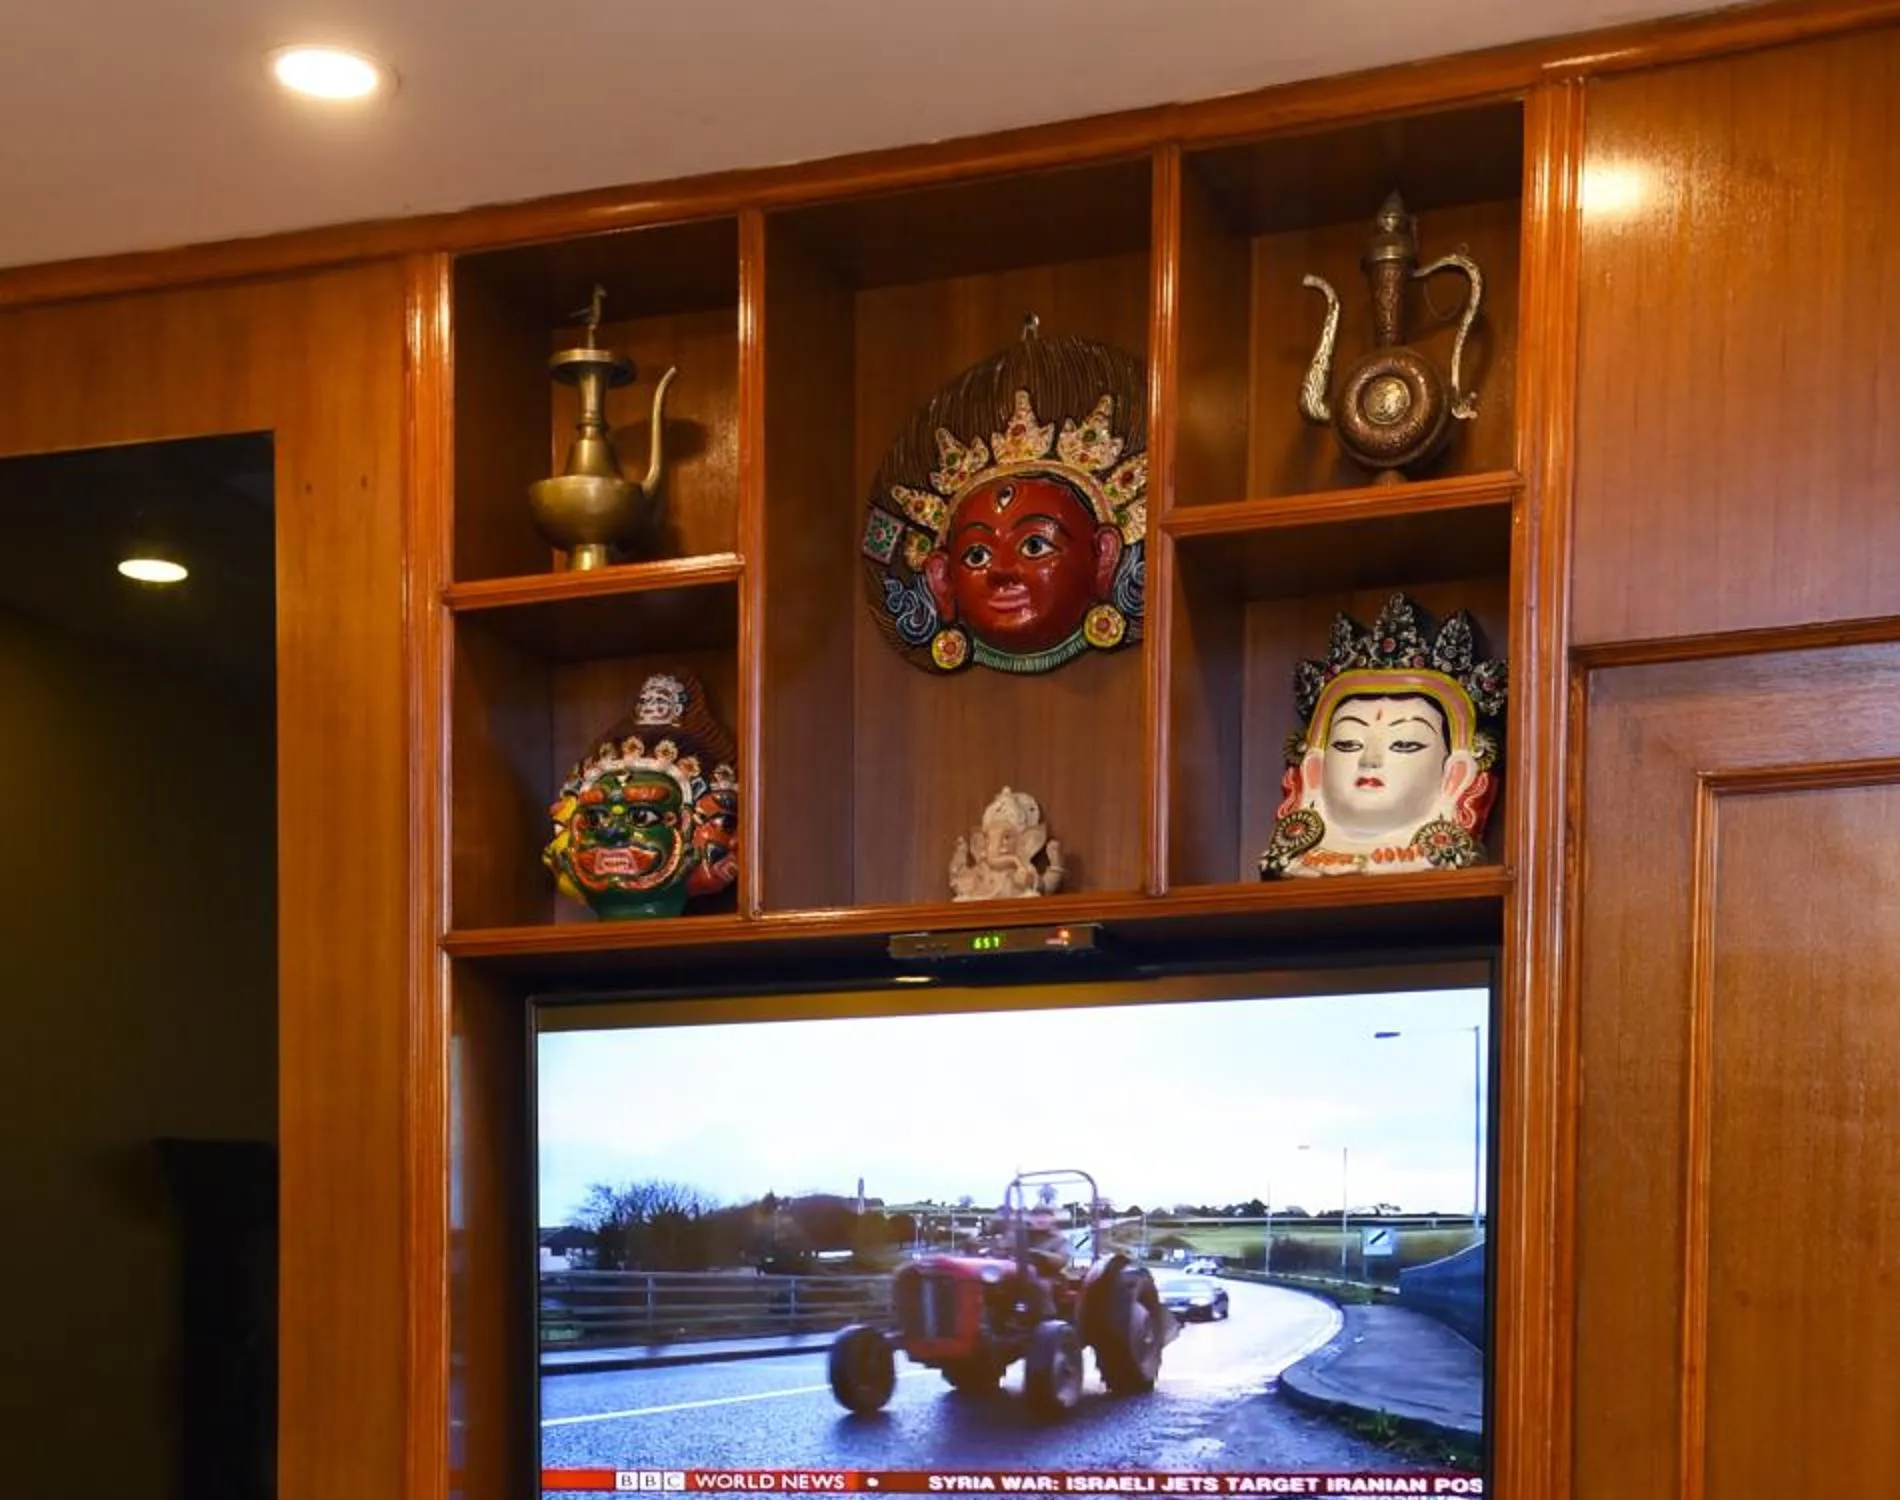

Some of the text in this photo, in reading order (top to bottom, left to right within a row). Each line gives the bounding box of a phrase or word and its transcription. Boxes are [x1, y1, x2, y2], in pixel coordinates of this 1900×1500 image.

[616, 1471, 845, 1490] BBC WORLD NEWS
[929, 1475, 1483, 1493] SYRIA WAR: ISRAELI JETS TARGET IRANIAN POS
